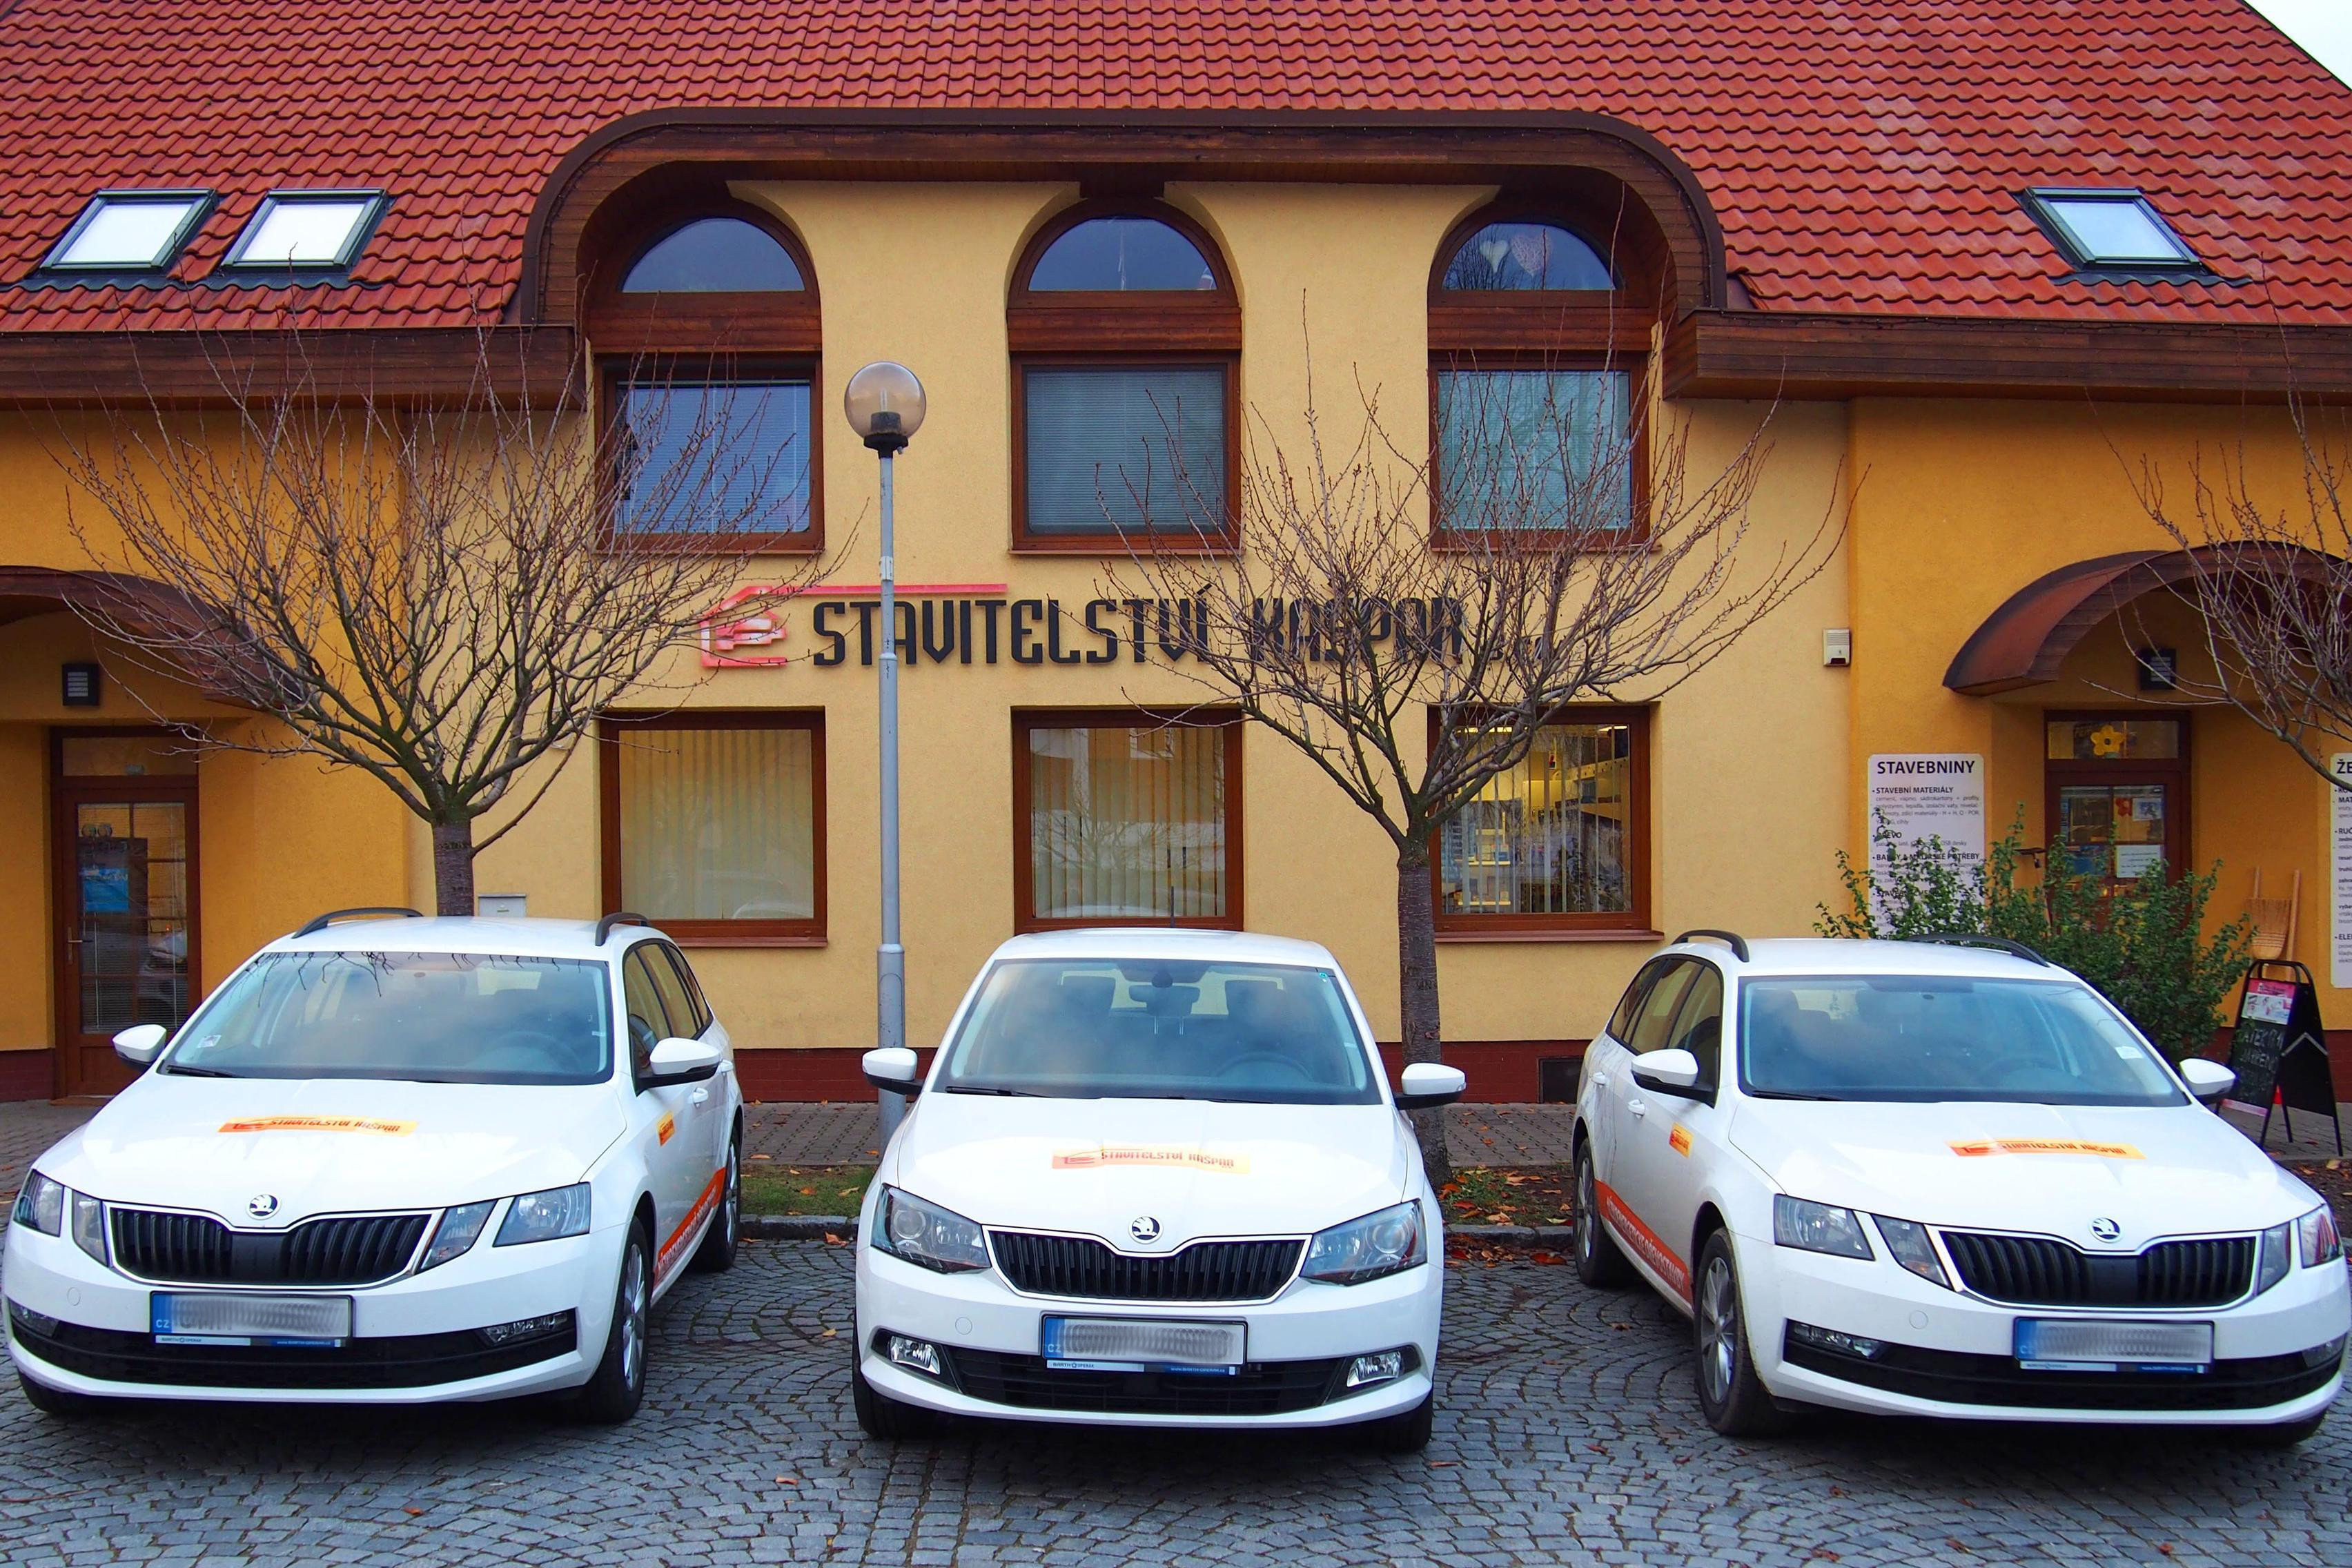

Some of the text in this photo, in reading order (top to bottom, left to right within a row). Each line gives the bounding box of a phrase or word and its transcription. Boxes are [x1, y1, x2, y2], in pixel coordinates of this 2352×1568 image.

[813, 582, 1212, 665] STAVITELSTVÍ
[1877, 761, 1975, 774] STAVEBNINY
[1913, 785, 1954, 794] MATERIÁLY
[1101, 1151, 1182, 1160] STAVITELSTVÍ
[156, 1319, 169, 1329] CZ
[1047, 1343, 1062, 1353] CZ
